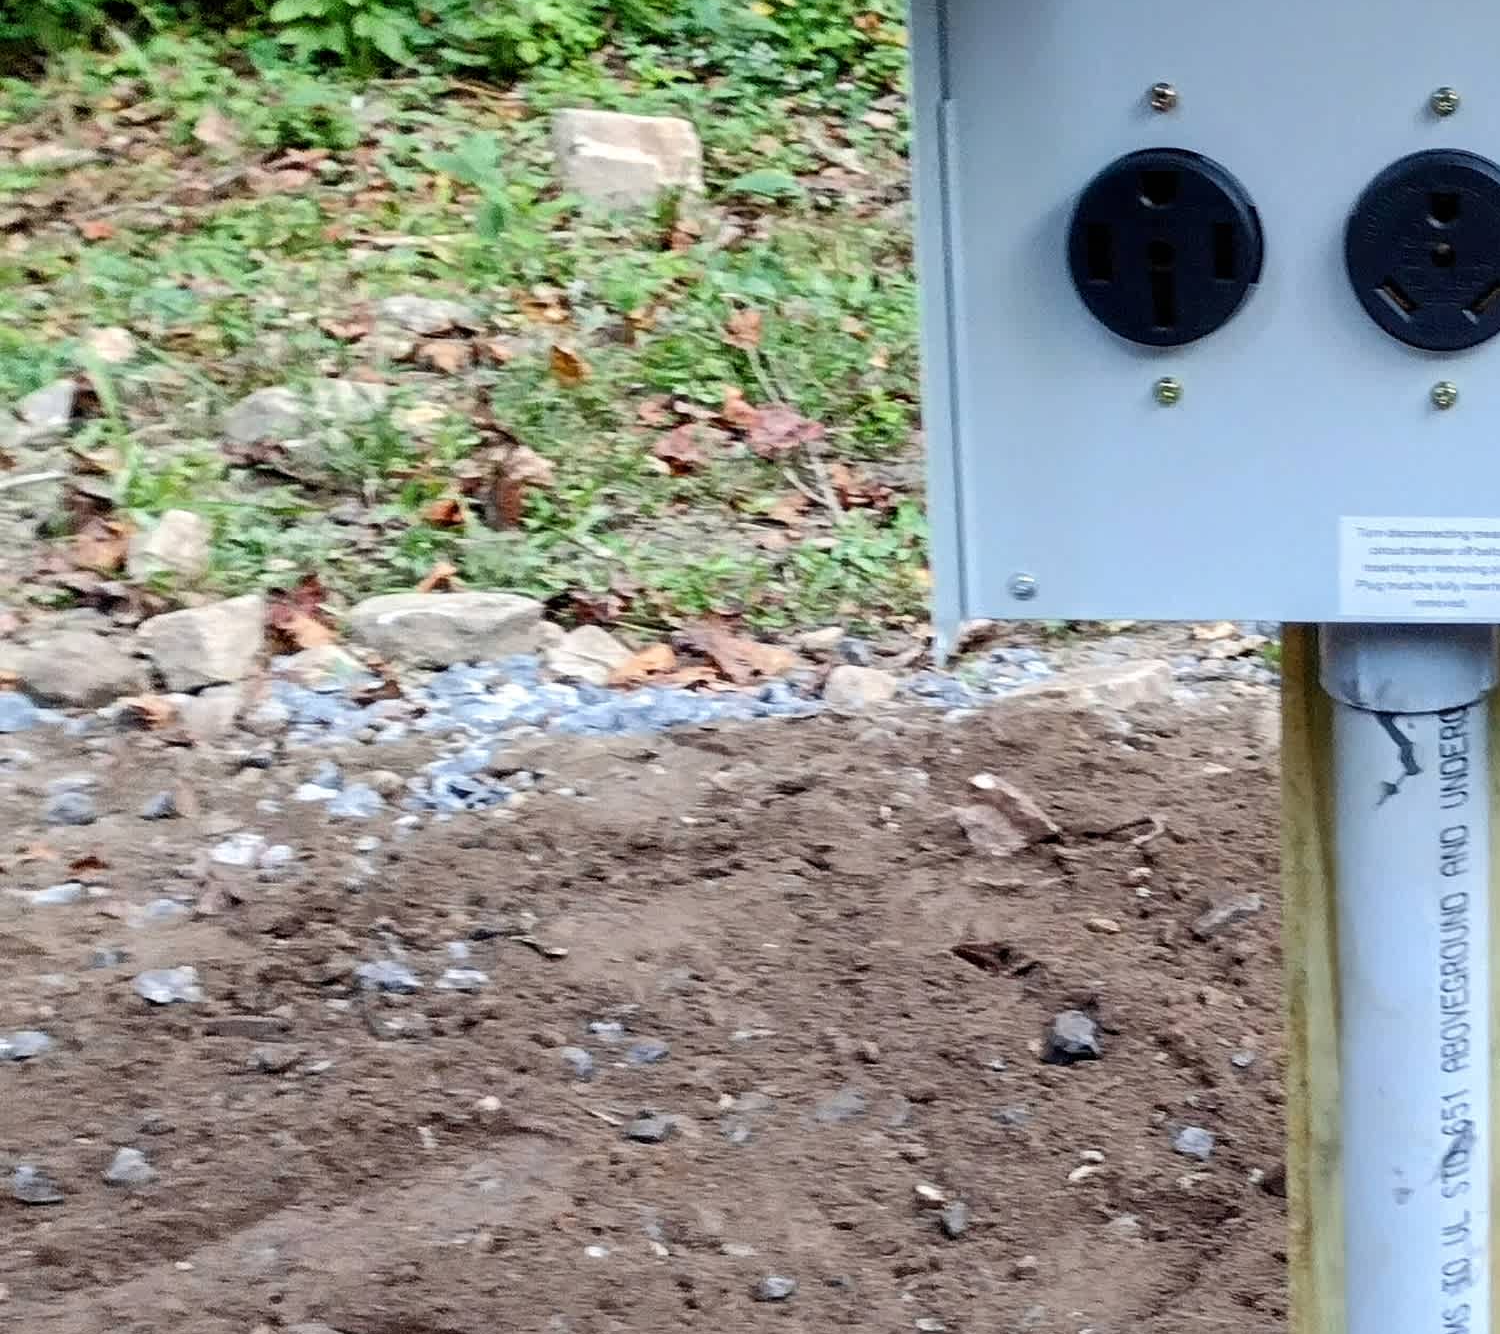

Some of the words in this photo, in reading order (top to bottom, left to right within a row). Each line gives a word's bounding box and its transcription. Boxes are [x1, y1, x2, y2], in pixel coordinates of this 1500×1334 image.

[1439, 824, 1469, 878] AND
[1439, 891, 1471, 1073] ABOVEGROUND
[1440, 1088, 1471, 1137] 651
[1441, 1149, 1471, 1199] STD
